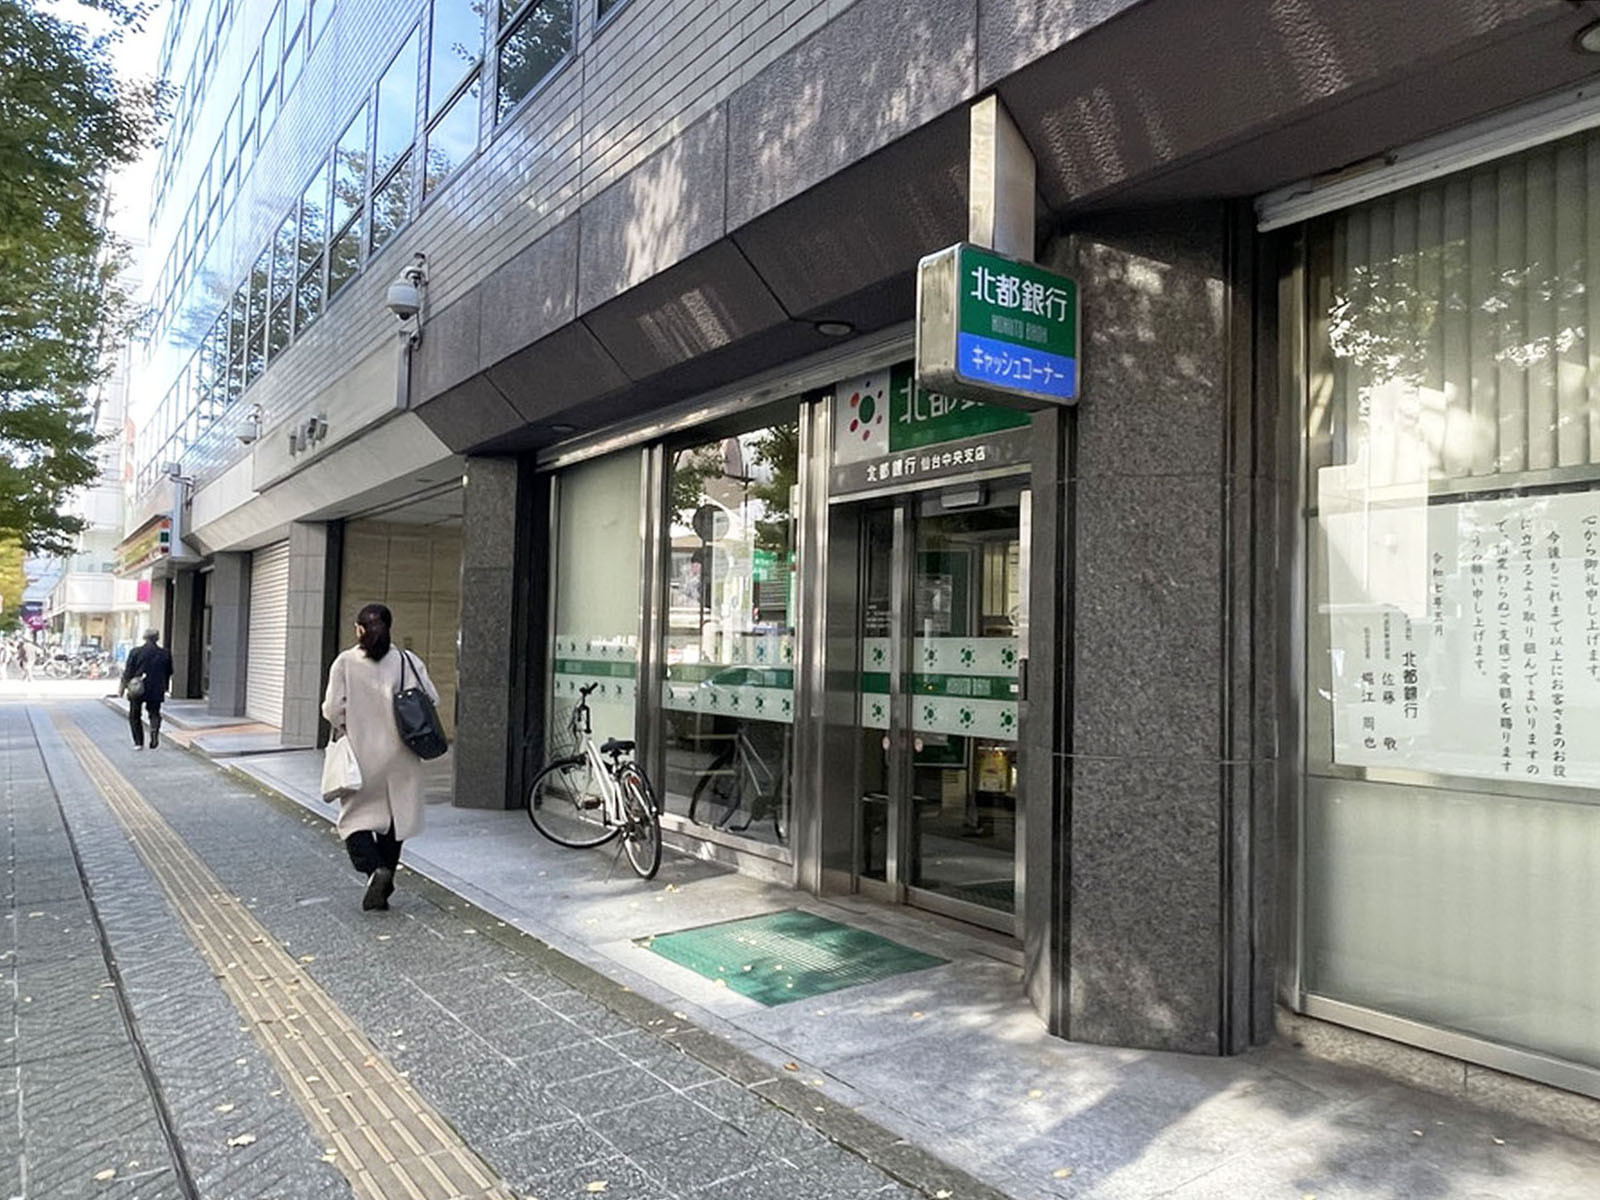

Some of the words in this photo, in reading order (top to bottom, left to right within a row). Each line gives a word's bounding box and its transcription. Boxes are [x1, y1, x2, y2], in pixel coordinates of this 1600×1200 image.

[971, 266, 1067, 322] 北都銀行
[972, 344, 1065, 385] キャッシュコーナー
[866, 456, 916, 482] 北都銀行
[920, 445, 986, 472] 仙台中央支店
[1402, 650, 1418, 719] 北都銀行
